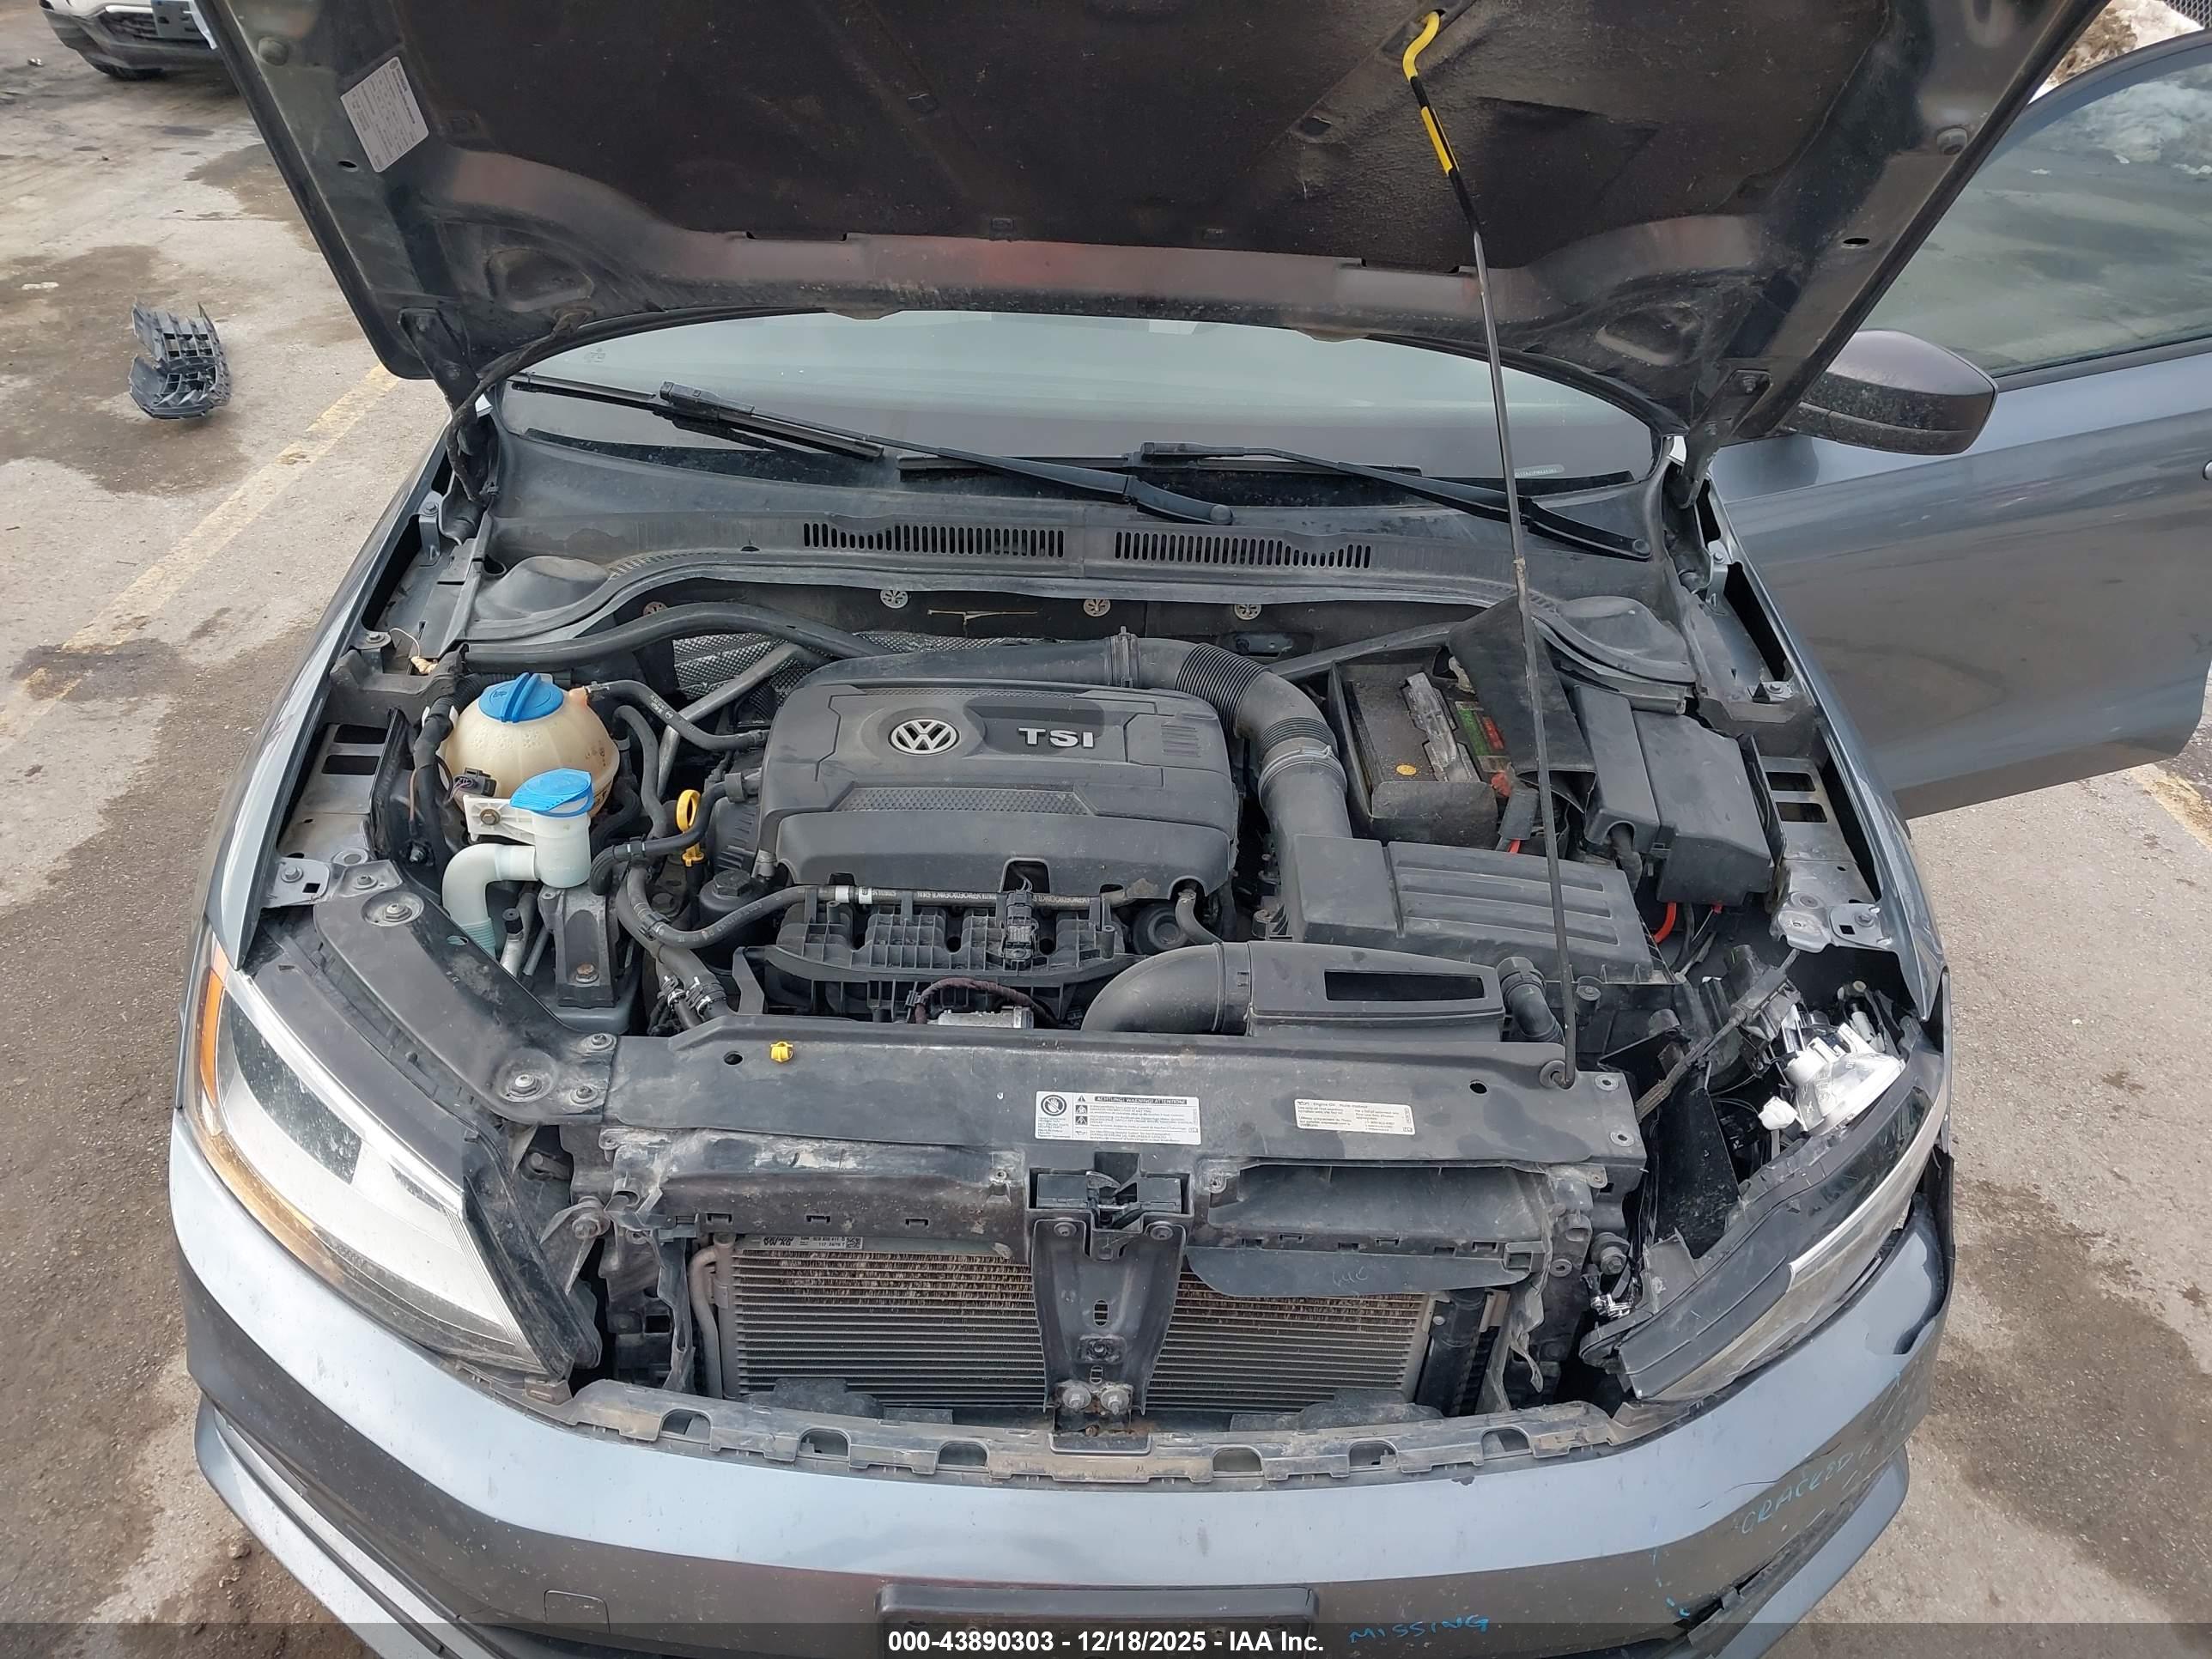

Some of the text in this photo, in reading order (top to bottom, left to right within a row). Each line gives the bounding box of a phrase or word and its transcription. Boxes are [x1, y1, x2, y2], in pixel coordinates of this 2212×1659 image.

[1018, 727, 1095, 749] TSI
[1741, 1451, 1853, 1534] CRACKED
[1350, 1614, 1489, 1643] MISSING
